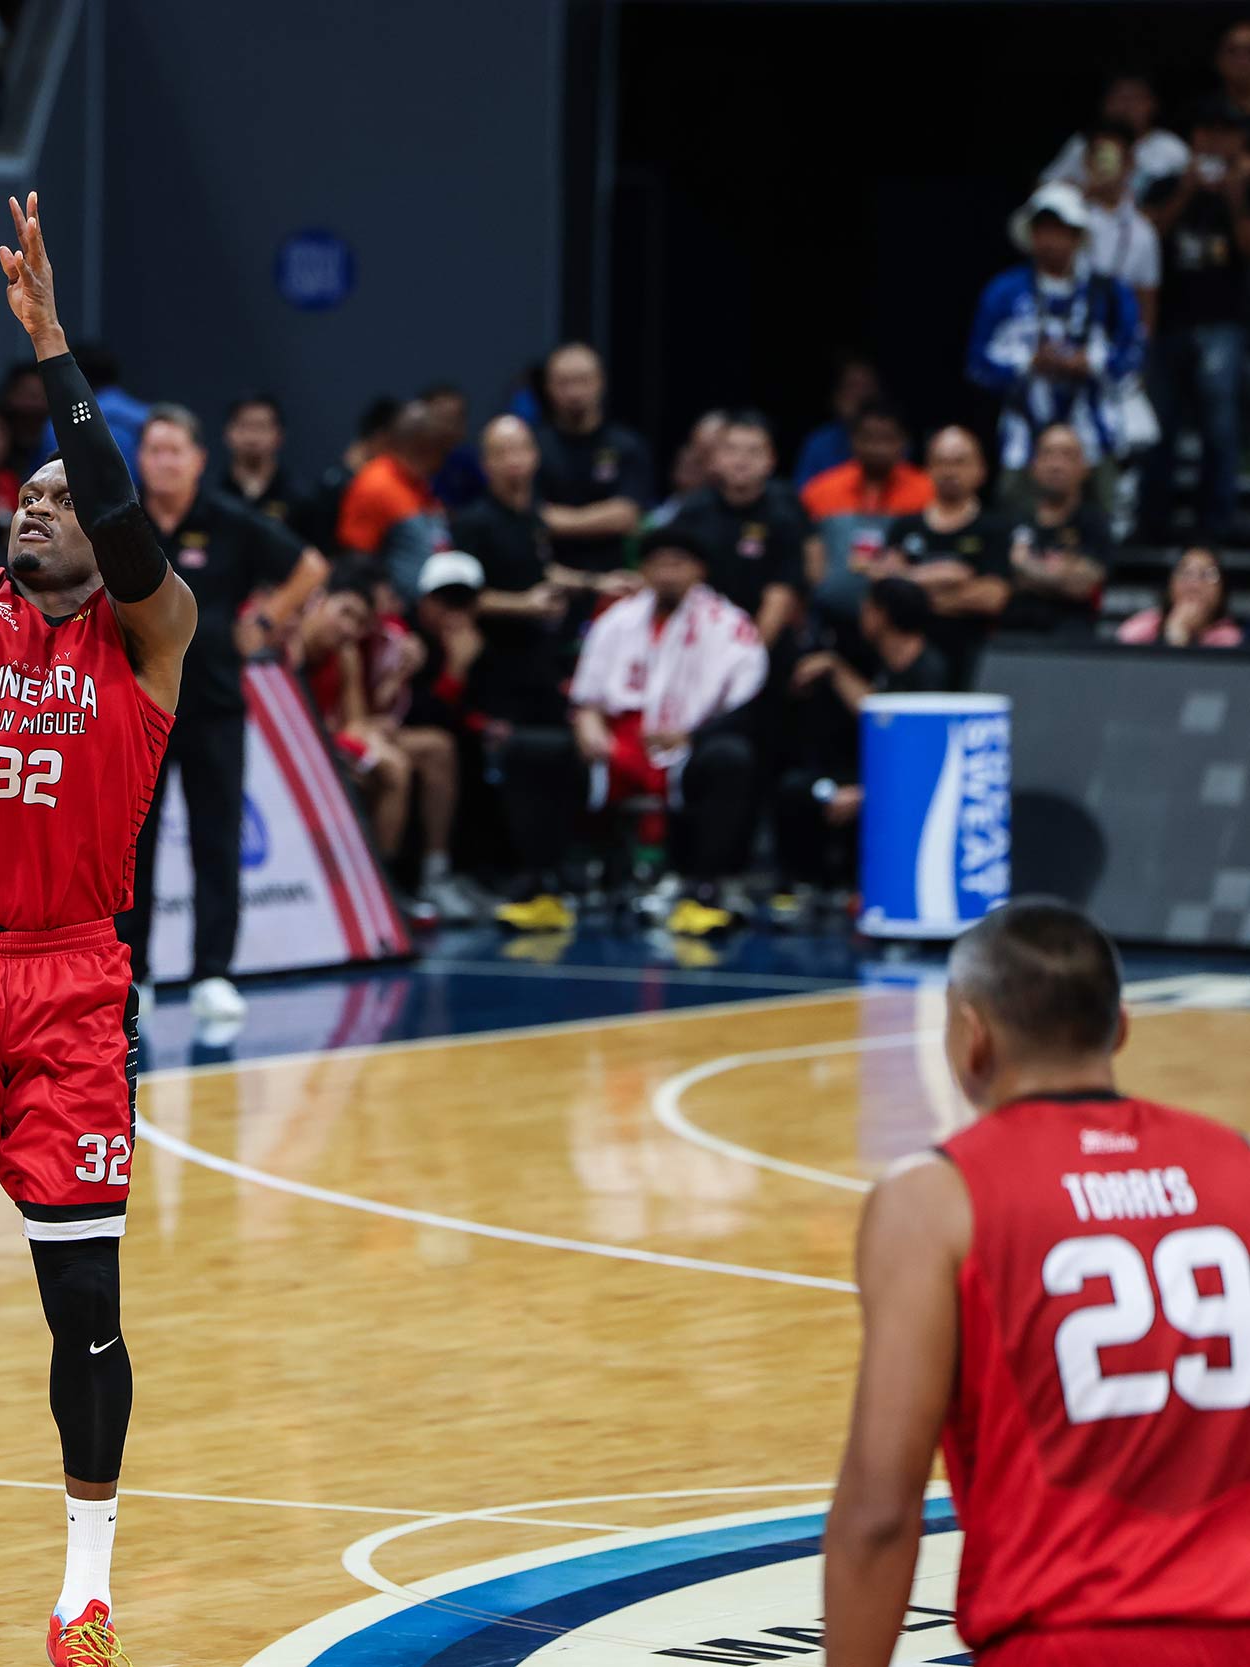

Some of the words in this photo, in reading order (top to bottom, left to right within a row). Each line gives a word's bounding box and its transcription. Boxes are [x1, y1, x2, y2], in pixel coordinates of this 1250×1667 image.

[18, 711, 86, 734] MIGUEL
[75, 1133, 131, 1185] 32
[1061, 1166, 1198, 1222] TORRES
[1042, 1226, 1250, 1425] 29
